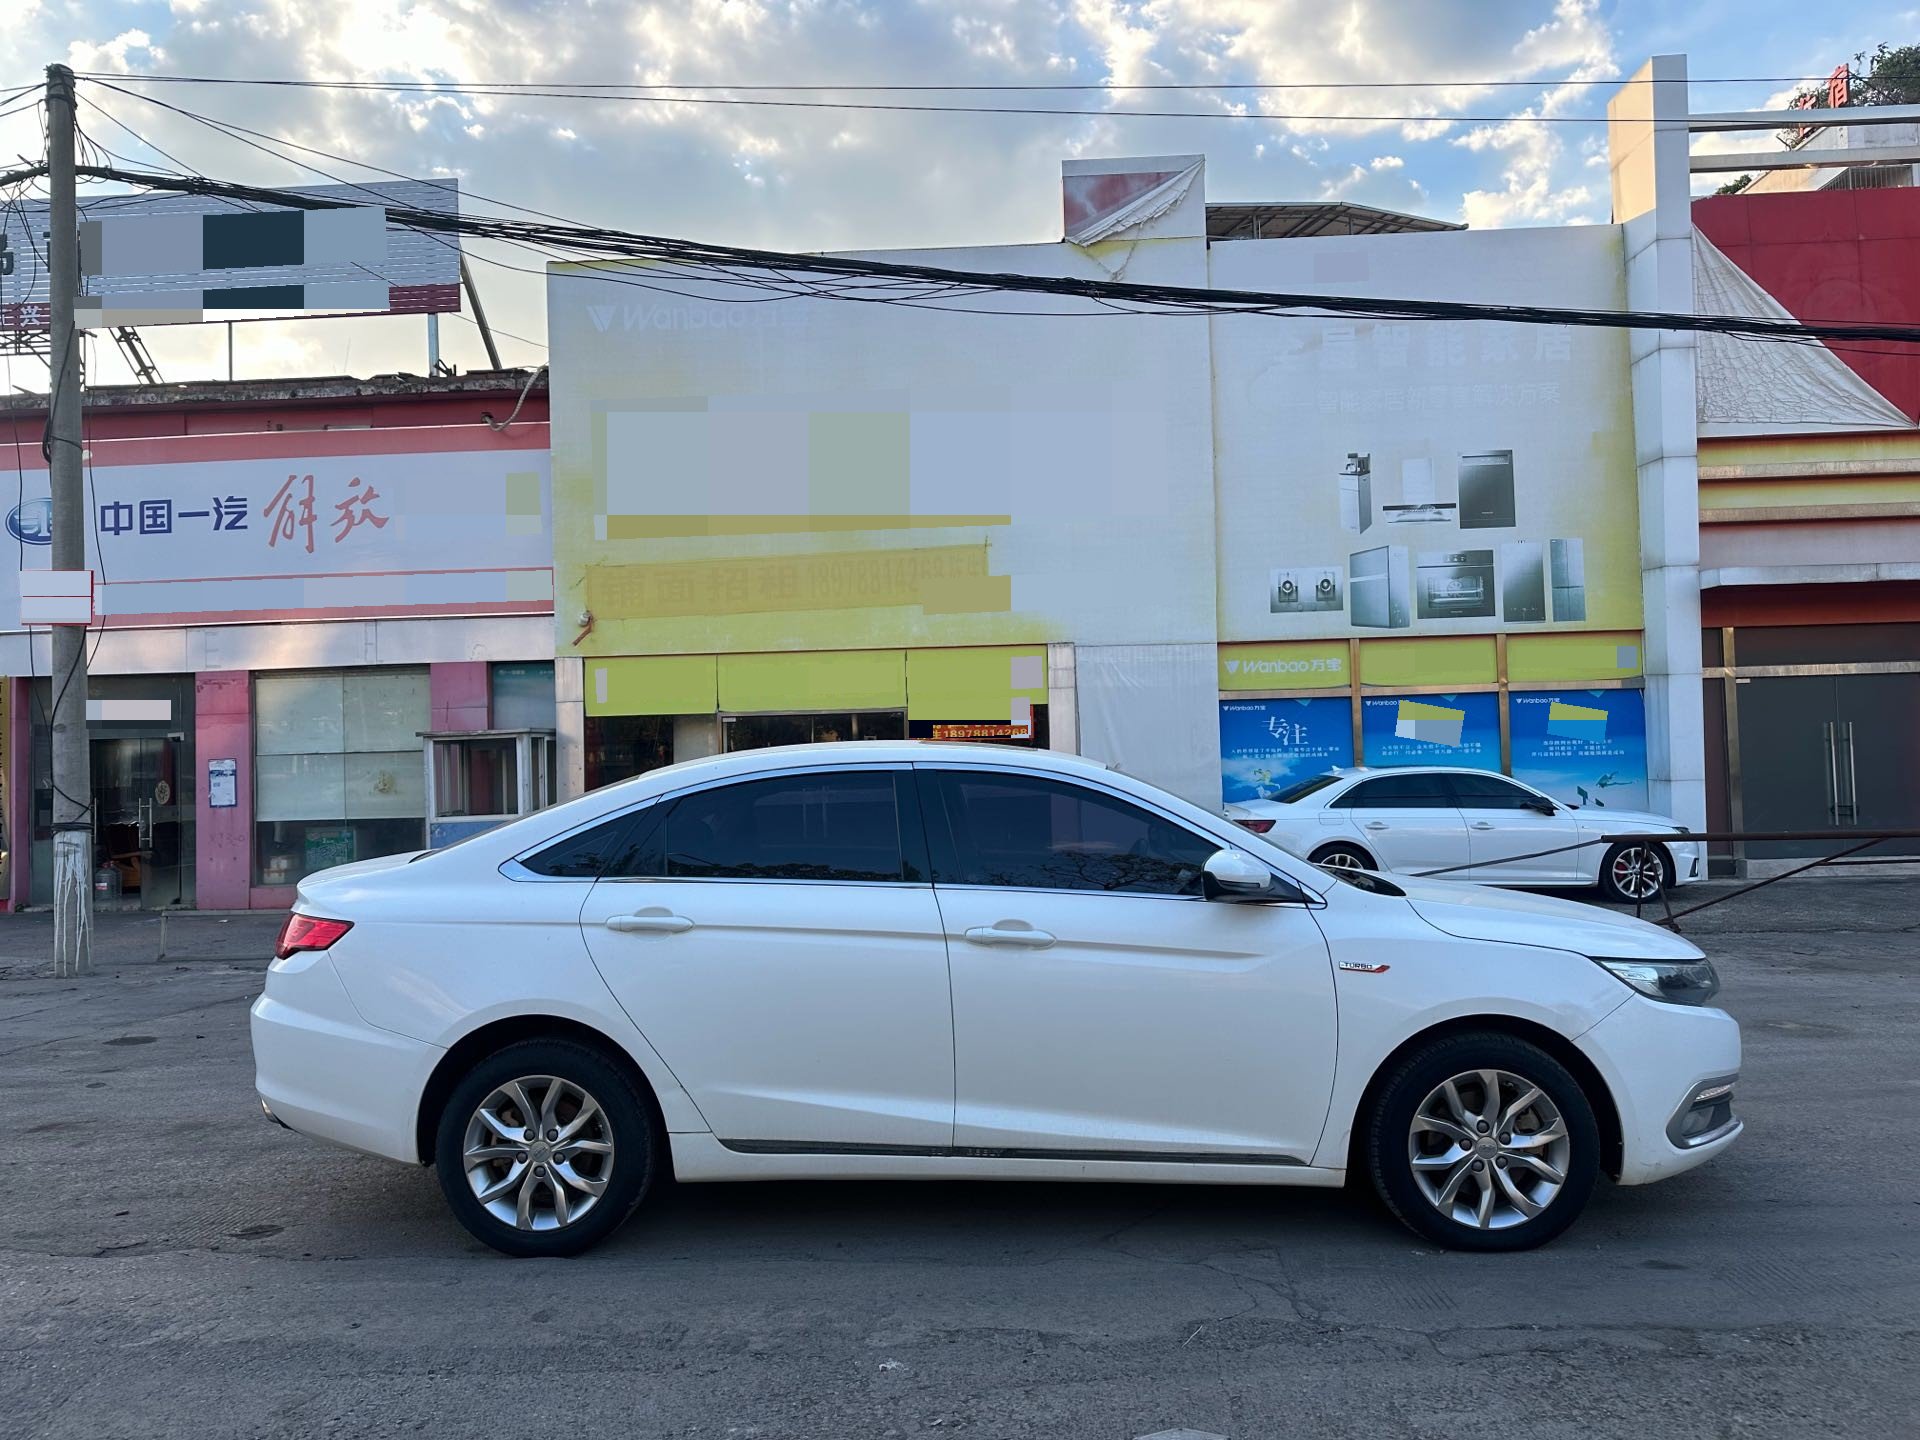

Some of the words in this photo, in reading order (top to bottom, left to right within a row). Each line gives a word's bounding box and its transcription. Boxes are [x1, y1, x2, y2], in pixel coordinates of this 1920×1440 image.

[100, 496, 248, 535] 中国一汽
[263, 475, 389, 553] 解放
[1261, 715, 1310, 746] 专注
